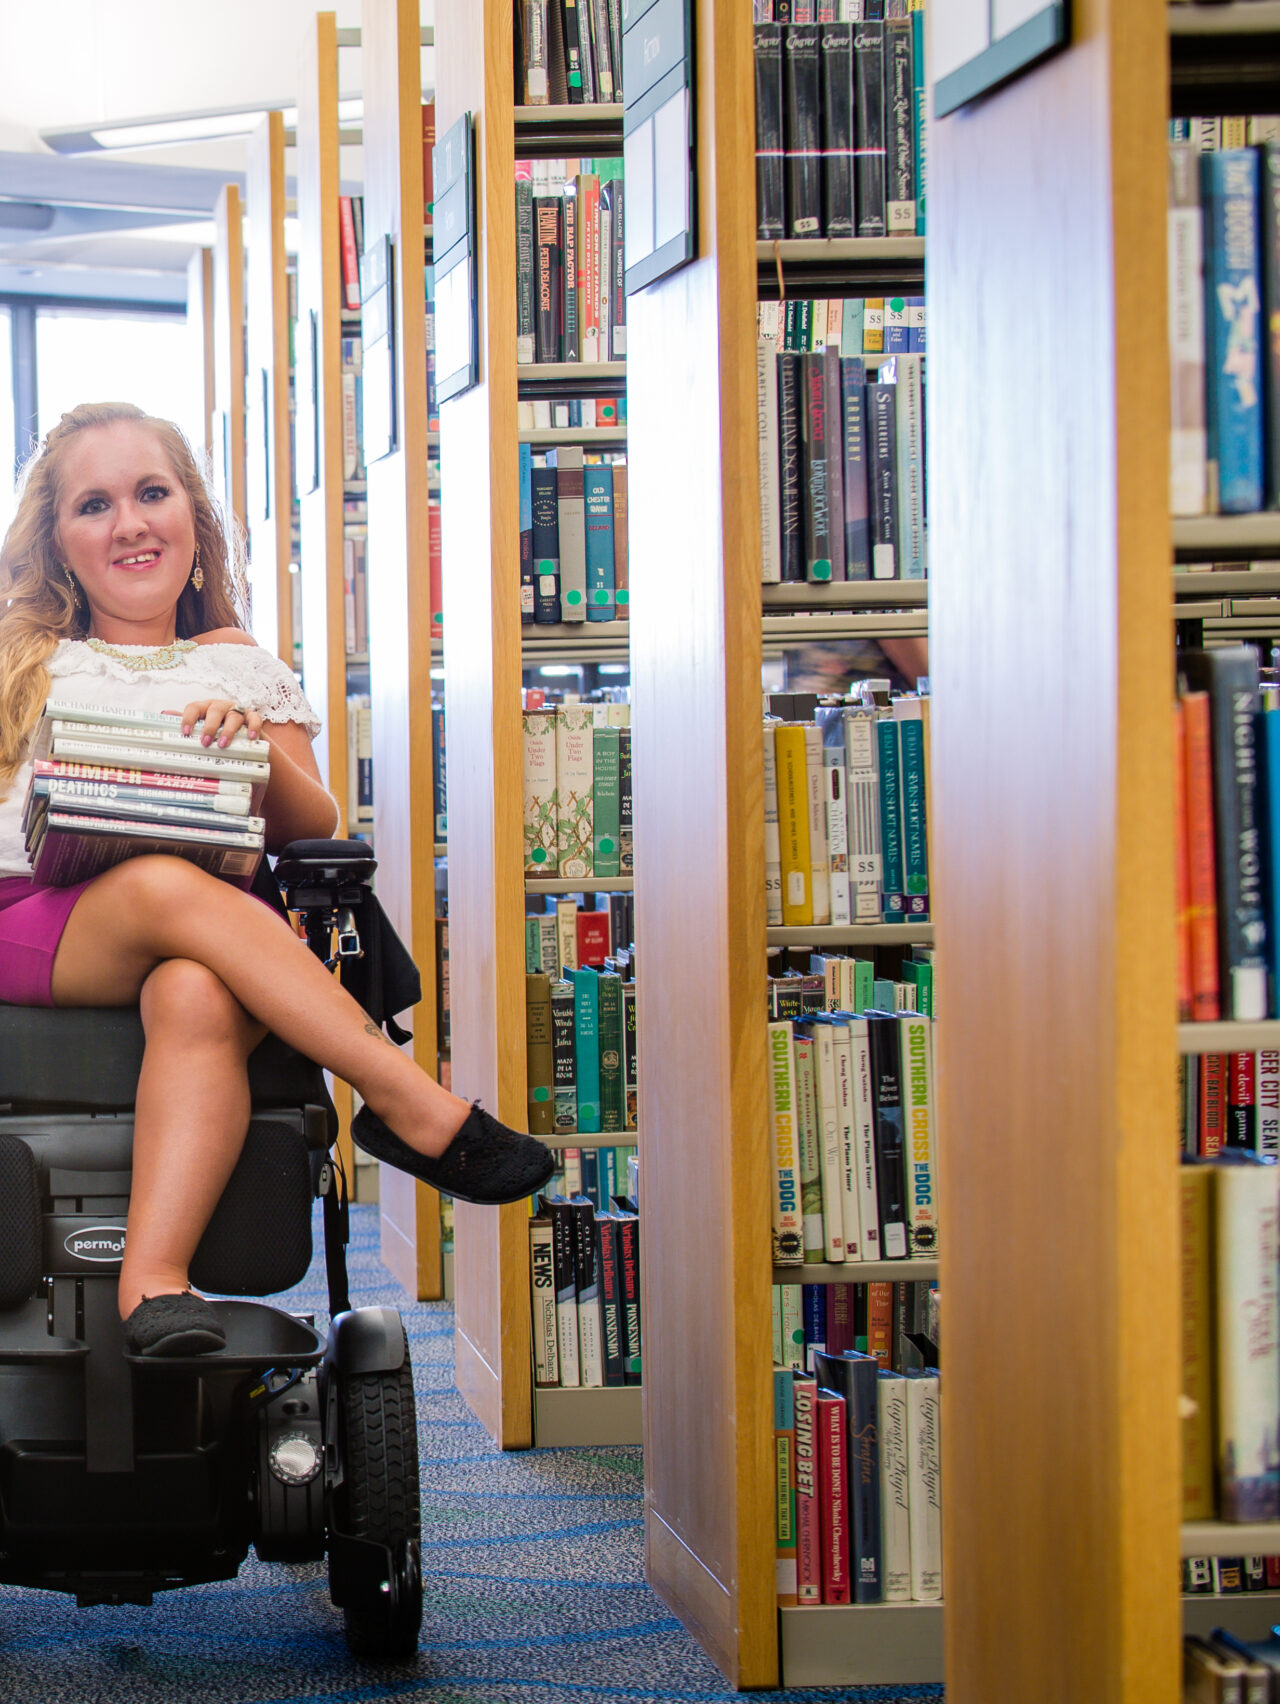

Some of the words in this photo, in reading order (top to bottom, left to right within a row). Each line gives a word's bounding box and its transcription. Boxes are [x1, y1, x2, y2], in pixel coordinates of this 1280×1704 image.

[896, 37, 906, 54] The
[893, 97, 910, 124] Radio
[897, 127, 909, 144] and
[538, 208, 558, 246] LEVANTINE
[894, 208, 910, 219] SS
[594, 233, 599, 251] ON
[540, 247, 550, 270] PETER
[594, 253, 599, 273] MY
[540, 270, 550, 311] DELACORTE
[870, 315, 882, 324] SS
[890, 311, 902, 320] SS
[757, 346, 767, 407] ELIZABETH
[758, 413, 768, 441] COLE
[846, 397, 860, 462] HARMONY
[759, 452, 769, 490] SUSAN
[760, 494, 770, 546] CHEEVER
[814, 510, 828, 536] Work
[54, 700, 100, 712] RICHARD
[102, 706, 136, 716] BARTH
[54, 762, 141, 784] JUMPER
[156, 780, 195, 788] BARTH
[884, 769, 896, 796] SEVEN
[908, 772, 919, 798] SEVEN
[48, 779, 118, 798] DEATHICS
[138, 788, 174, 799] RICHARD
[175, 792, 204, 802] BARTH
[886, 797, 896, 826] SHORT
[908, 799, 920, 829] SHORT
[830, 801, 839, 853] CHEKHOV
[887, 830, 898, 863] NOVELS
[910, 831, 921, 865] NOVELS
[858, 862, 874, 872] SS
[1238, 828, 1261, 906] WOLF
[765, 879, 780, 890] SS
[542, 924, 556, 942] THE
[553, 1009, 574, 1018] Variable
[555, 1018, 572, 1026] Winds
[556, 1038, 572, 1046] Jalna
[772, 1029, 790, 1112] SOUTHERN
[909, 1024, 927, 1106] SOUTHERN
[1238, 1053, 1250, 1070] the
[1260, 1050, 1279, 1074] GER
[1207, 1080, 1220, 1097] BAD
[1238, 1074, 1250, 1108] devil's
[1260, 1080, 1279, 1108] CITY
[1207, 1100, 1220, 1128] BLOOD
[1234, 1110, 1246, 1140] game
[776, 1114, 794, 1167] CROSS
[912, 1108, 929, 1161] CROSS
[1262, 1120, 1278, 1149] SEAN
[778, 1169, 793, 1178] THE
[914, 1163, 928, 1172] THE
[778, 1180, 795, 1212] DOG
[915, 1174, 931, 1205] DOG
[601, 1223, 613, 1259] Nicholas
[622, 1223, 634, 1258] Nicholas
[532, 1242, 553, 1288] NEWS
[544, 1299, 554, 1337] Nicholas
[603, 1260, 614, 1299] Delbanco
[624, 1259, 636, 1299] Delbanco
[606, 1304, 618, 1360] POSSESSION
[626, 1303, 640, 1358] POSSESSION
[796, 1391, 813, 1458] LOSING
[830, 1406, 840, 1433] WHAT
[886, 1388, 906, 1451] Augusta
[920, 1388, 936, 1451] Augusta
[779, 1440, 788, 1455] SOME
[830, 1435, 840, 1444] IS
[831, 1444, 840, 1456] TO
[779, 1468, 788, 1480] HER
[832, 1456, 841, 1468] BE
[780, 1481, 788, 1504] FRIENDS
[797, 1460, 814, 1498] BET
[832, 1469, 842, 1498] DONE?
[889, 1455, 908, 1511] Played
[921, 1455, 940, 1511] Played
[780, 1508, 788, 1522] THAT
[802, 1500, 810, 1529] MIKHAIL
[832, 1500, 842, 1526] Nikolai
[780, 1525, 788, 1537] YEAR
[830, 1527, 843, 1582] Chernyshevsky
